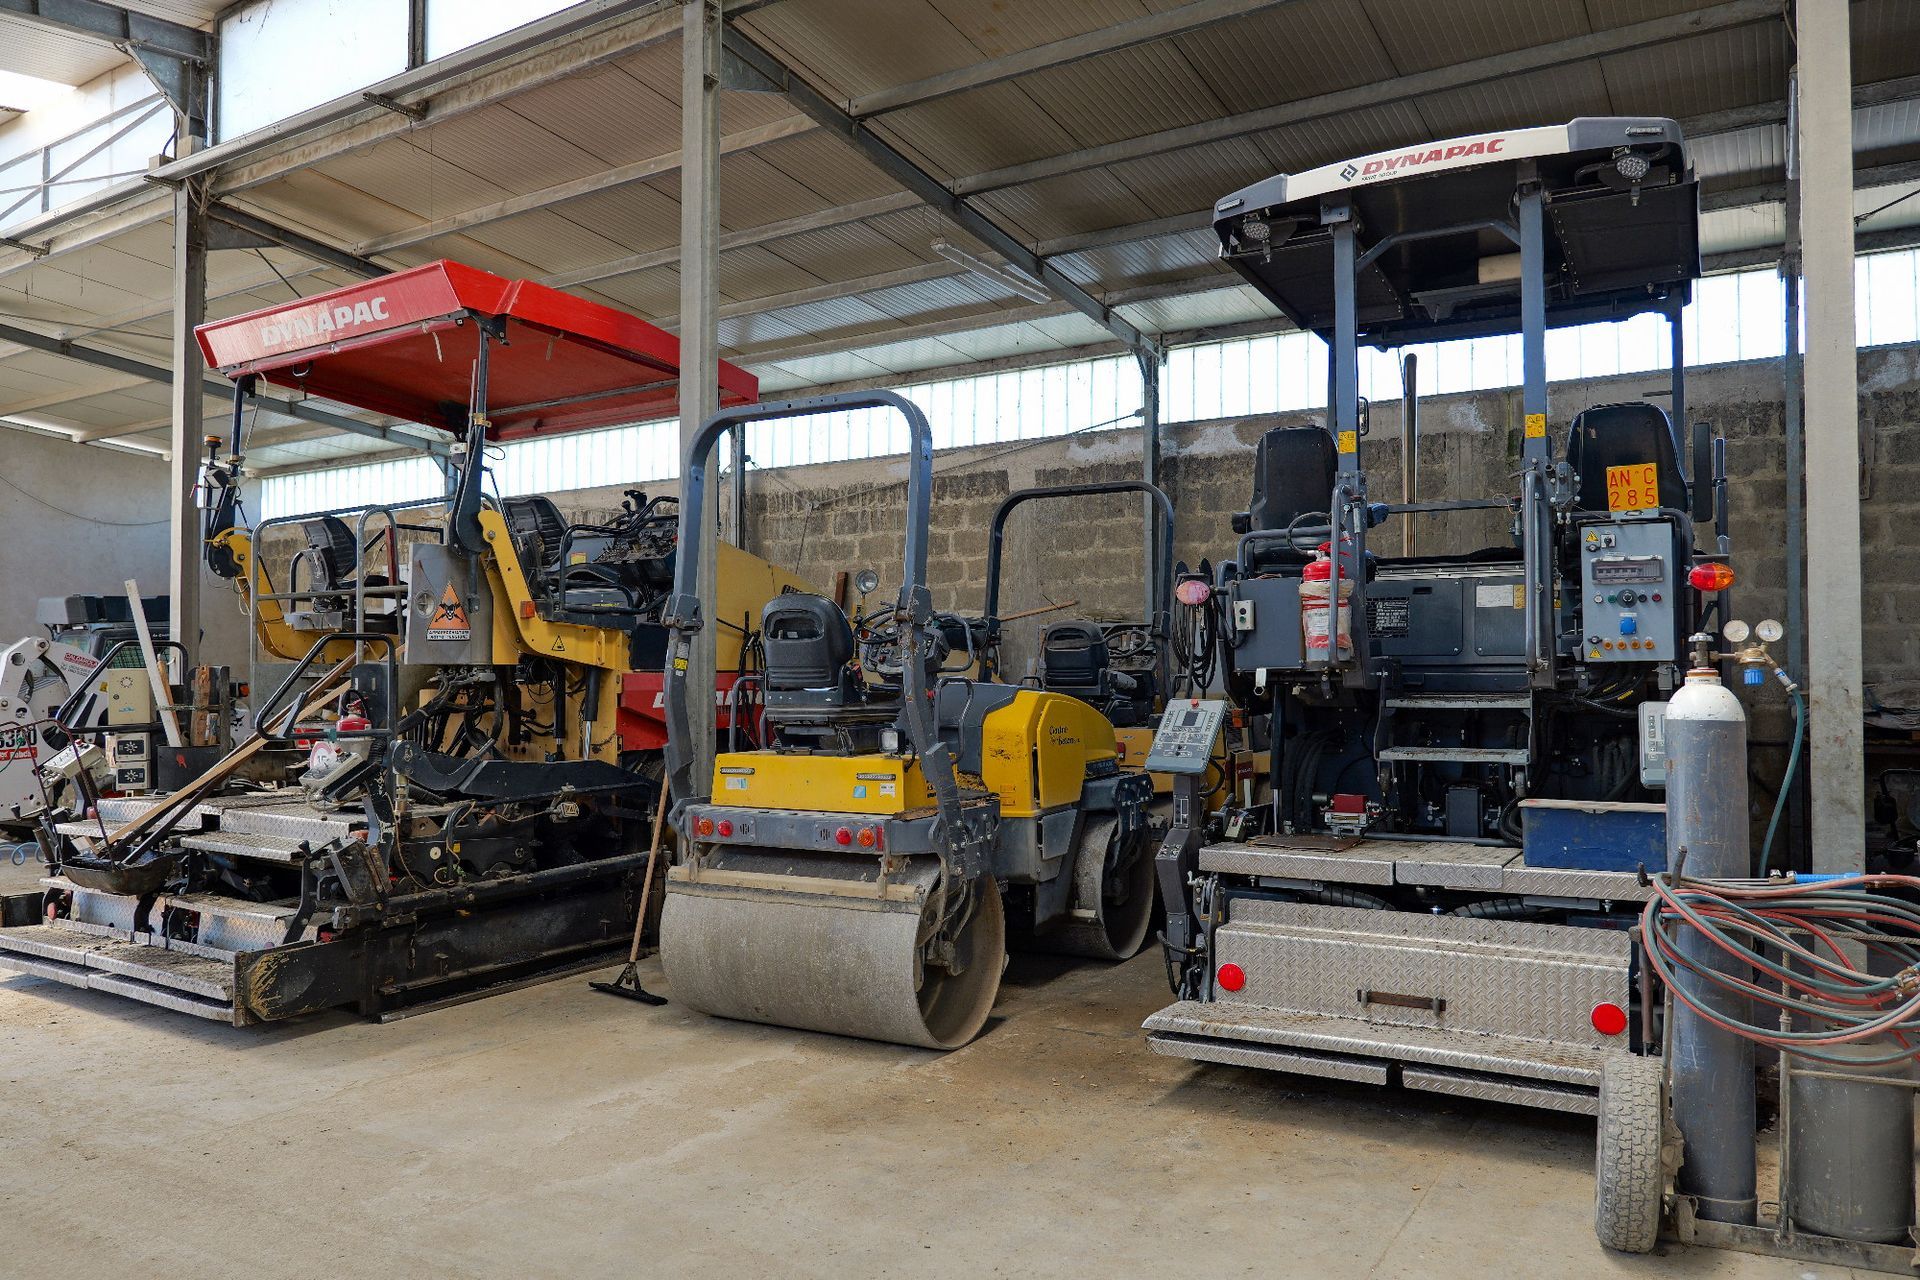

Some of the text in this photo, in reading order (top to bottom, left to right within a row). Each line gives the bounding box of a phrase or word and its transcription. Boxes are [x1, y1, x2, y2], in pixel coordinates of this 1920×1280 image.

[1362, 139, 1505, 175] DYNAPAC
[261, 296, 389, 348] DYNAPAC
[1609, 467, 1655, 489] AN C
[1610, 487, 1656, 509] 285
